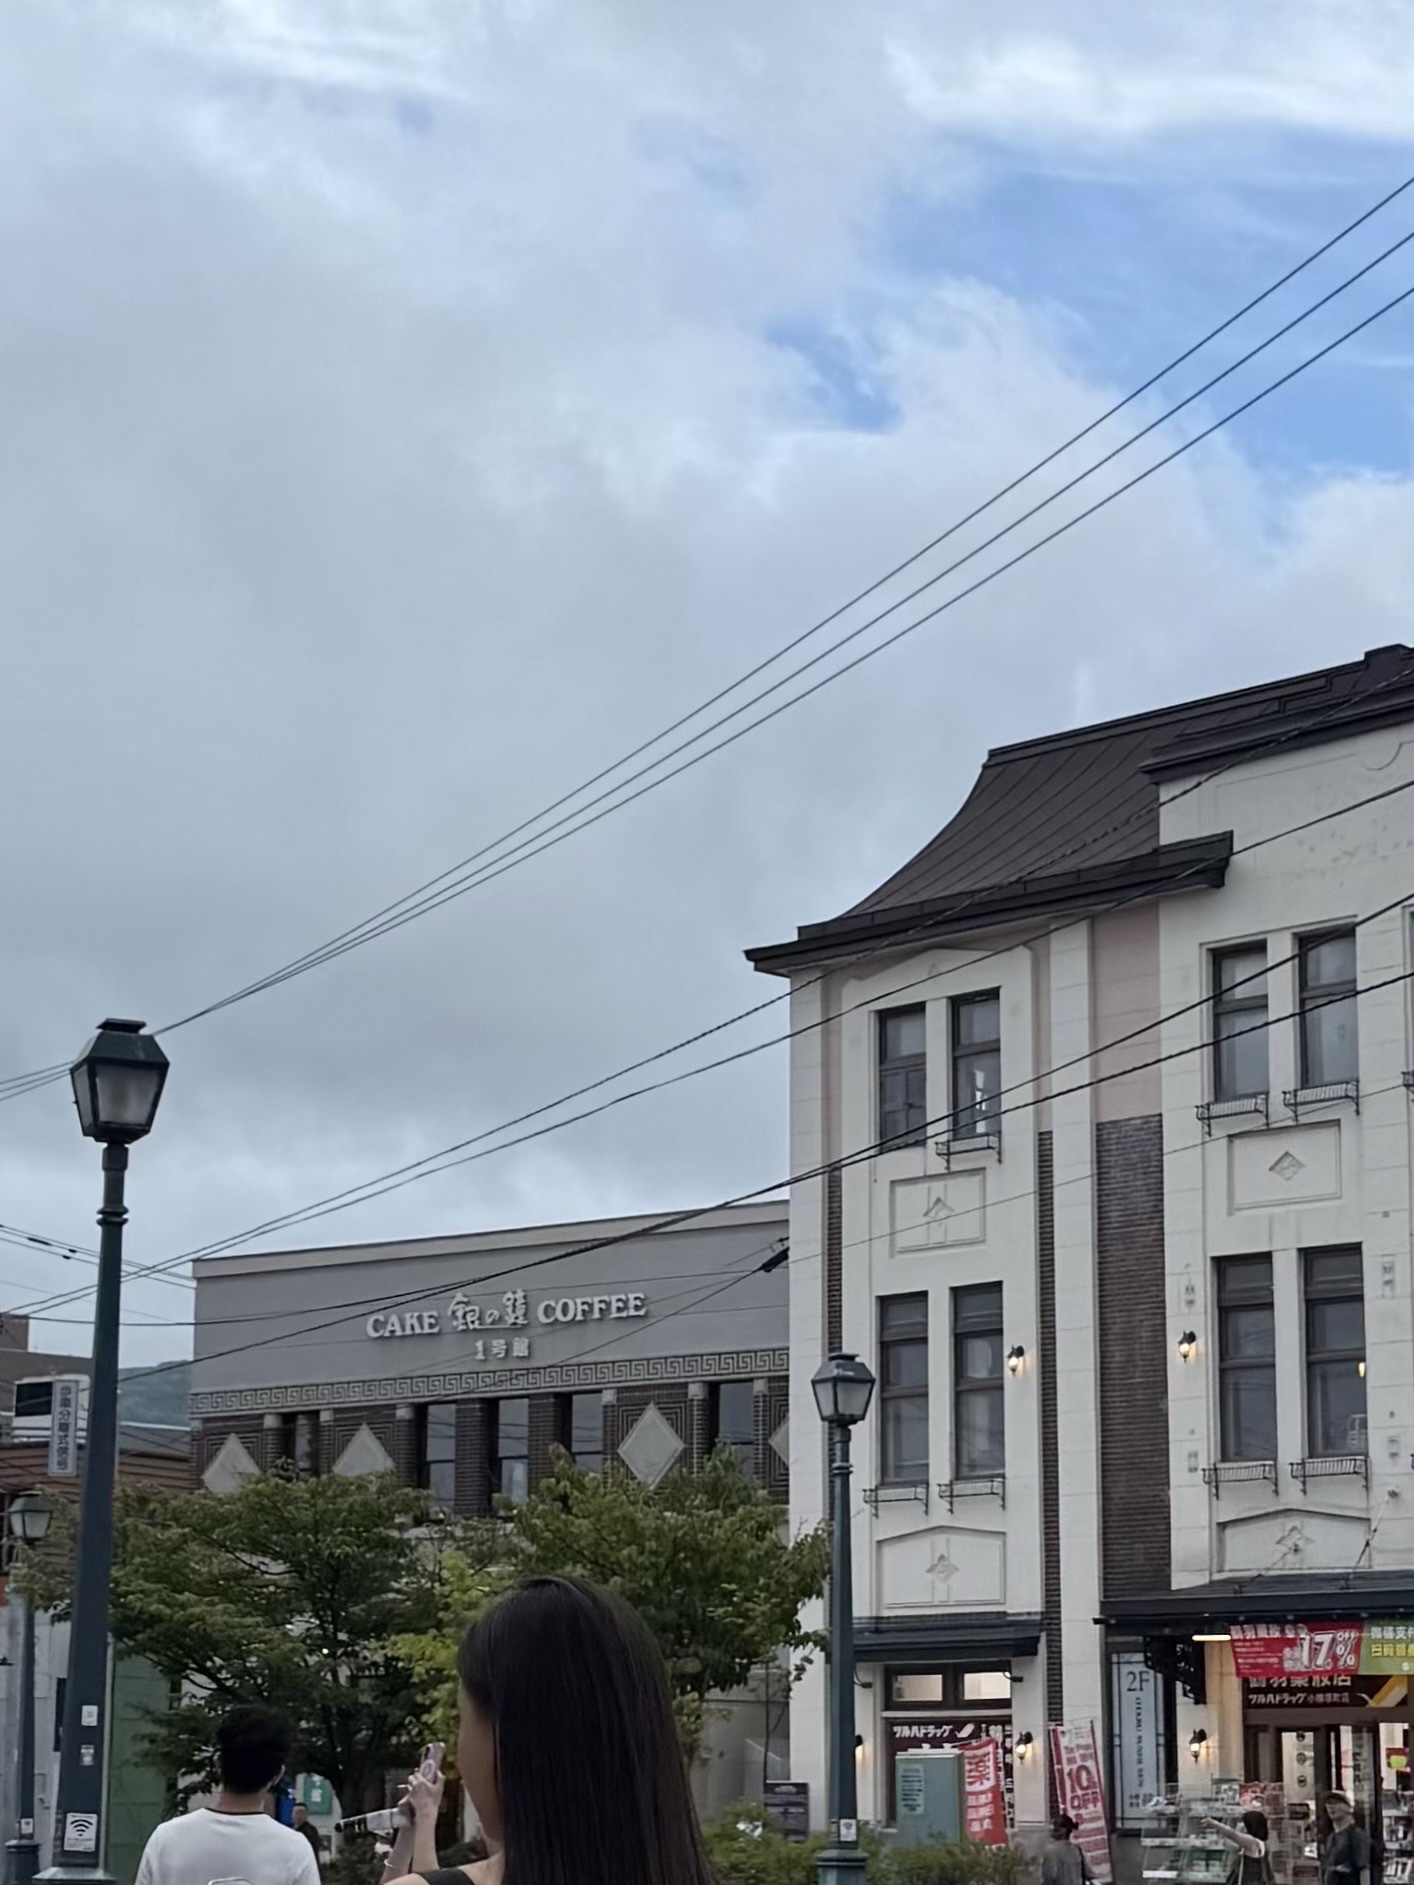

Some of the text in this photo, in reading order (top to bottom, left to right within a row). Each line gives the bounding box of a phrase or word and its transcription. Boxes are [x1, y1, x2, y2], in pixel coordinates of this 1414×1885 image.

[366, 1311, 440, 1337] CAKE
[537, 1292, 647, 1324] COFFEE
[474, 1337, 530, 1360] 1号館
[1126, 1671, 1150, 1691] 2F
[893, 1725, 953, 1738] ツルハドラッグ
[1070, 1791, 1100, 1811] OFF
